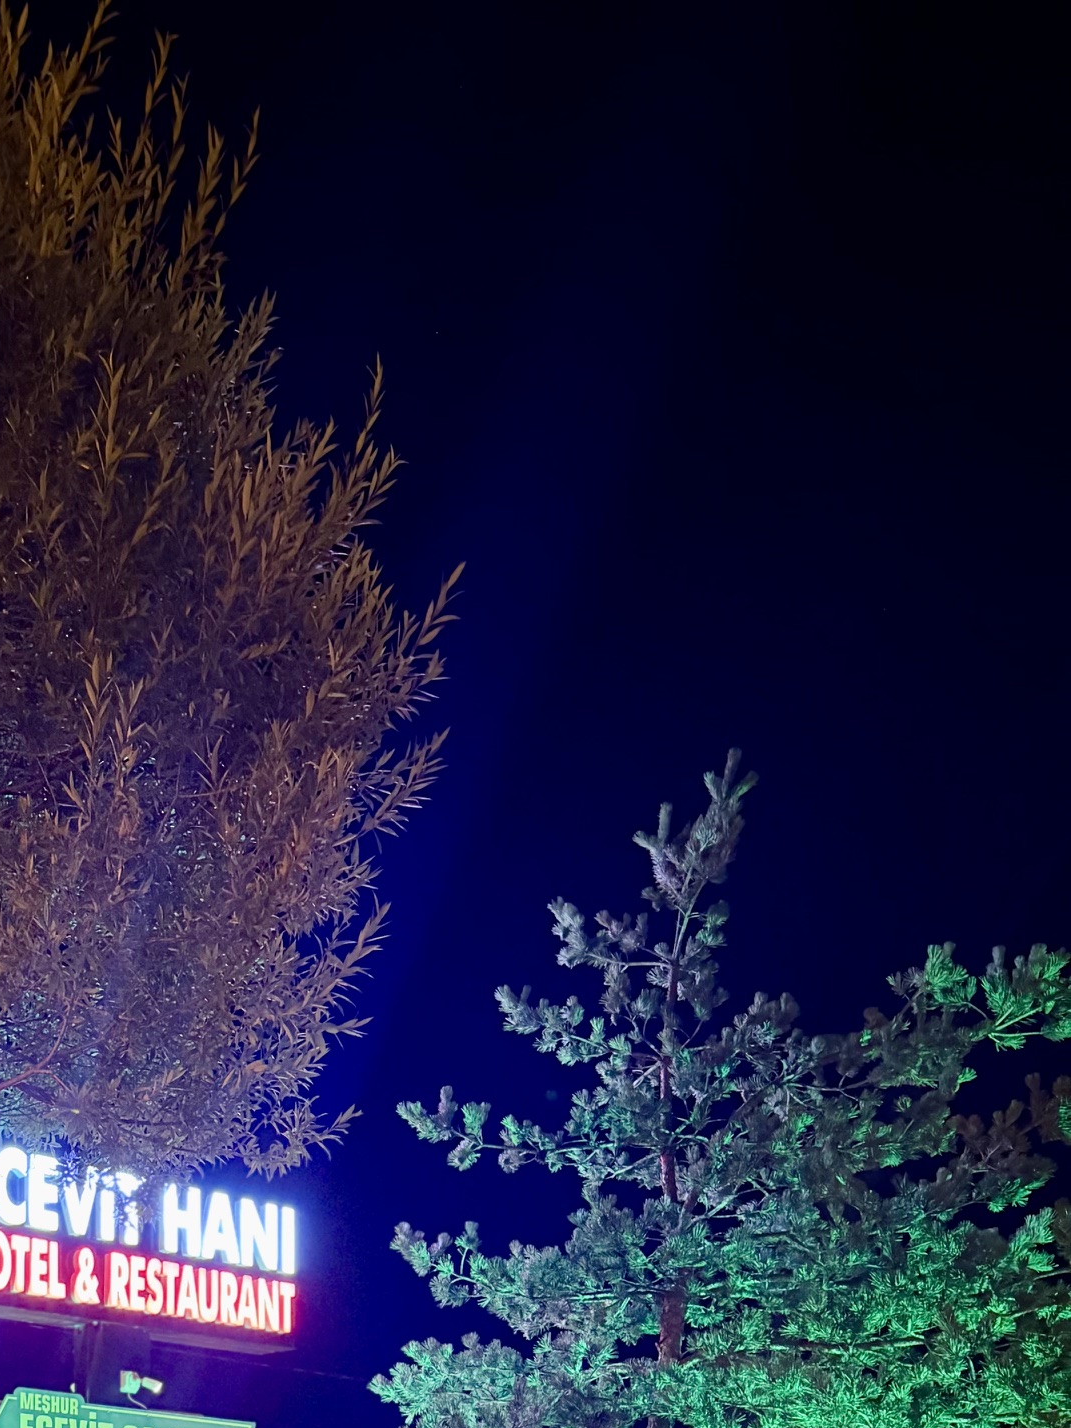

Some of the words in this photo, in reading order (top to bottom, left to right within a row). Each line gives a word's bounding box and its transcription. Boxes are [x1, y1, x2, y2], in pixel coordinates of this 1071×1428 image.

[163, 1181, 295, 1275] HANI
[74, 1246, 100, 1304] &
[107, 1251, 295, 1334] RESTAURANT
[19, 1391, 79, 1416] MEŞHUR
